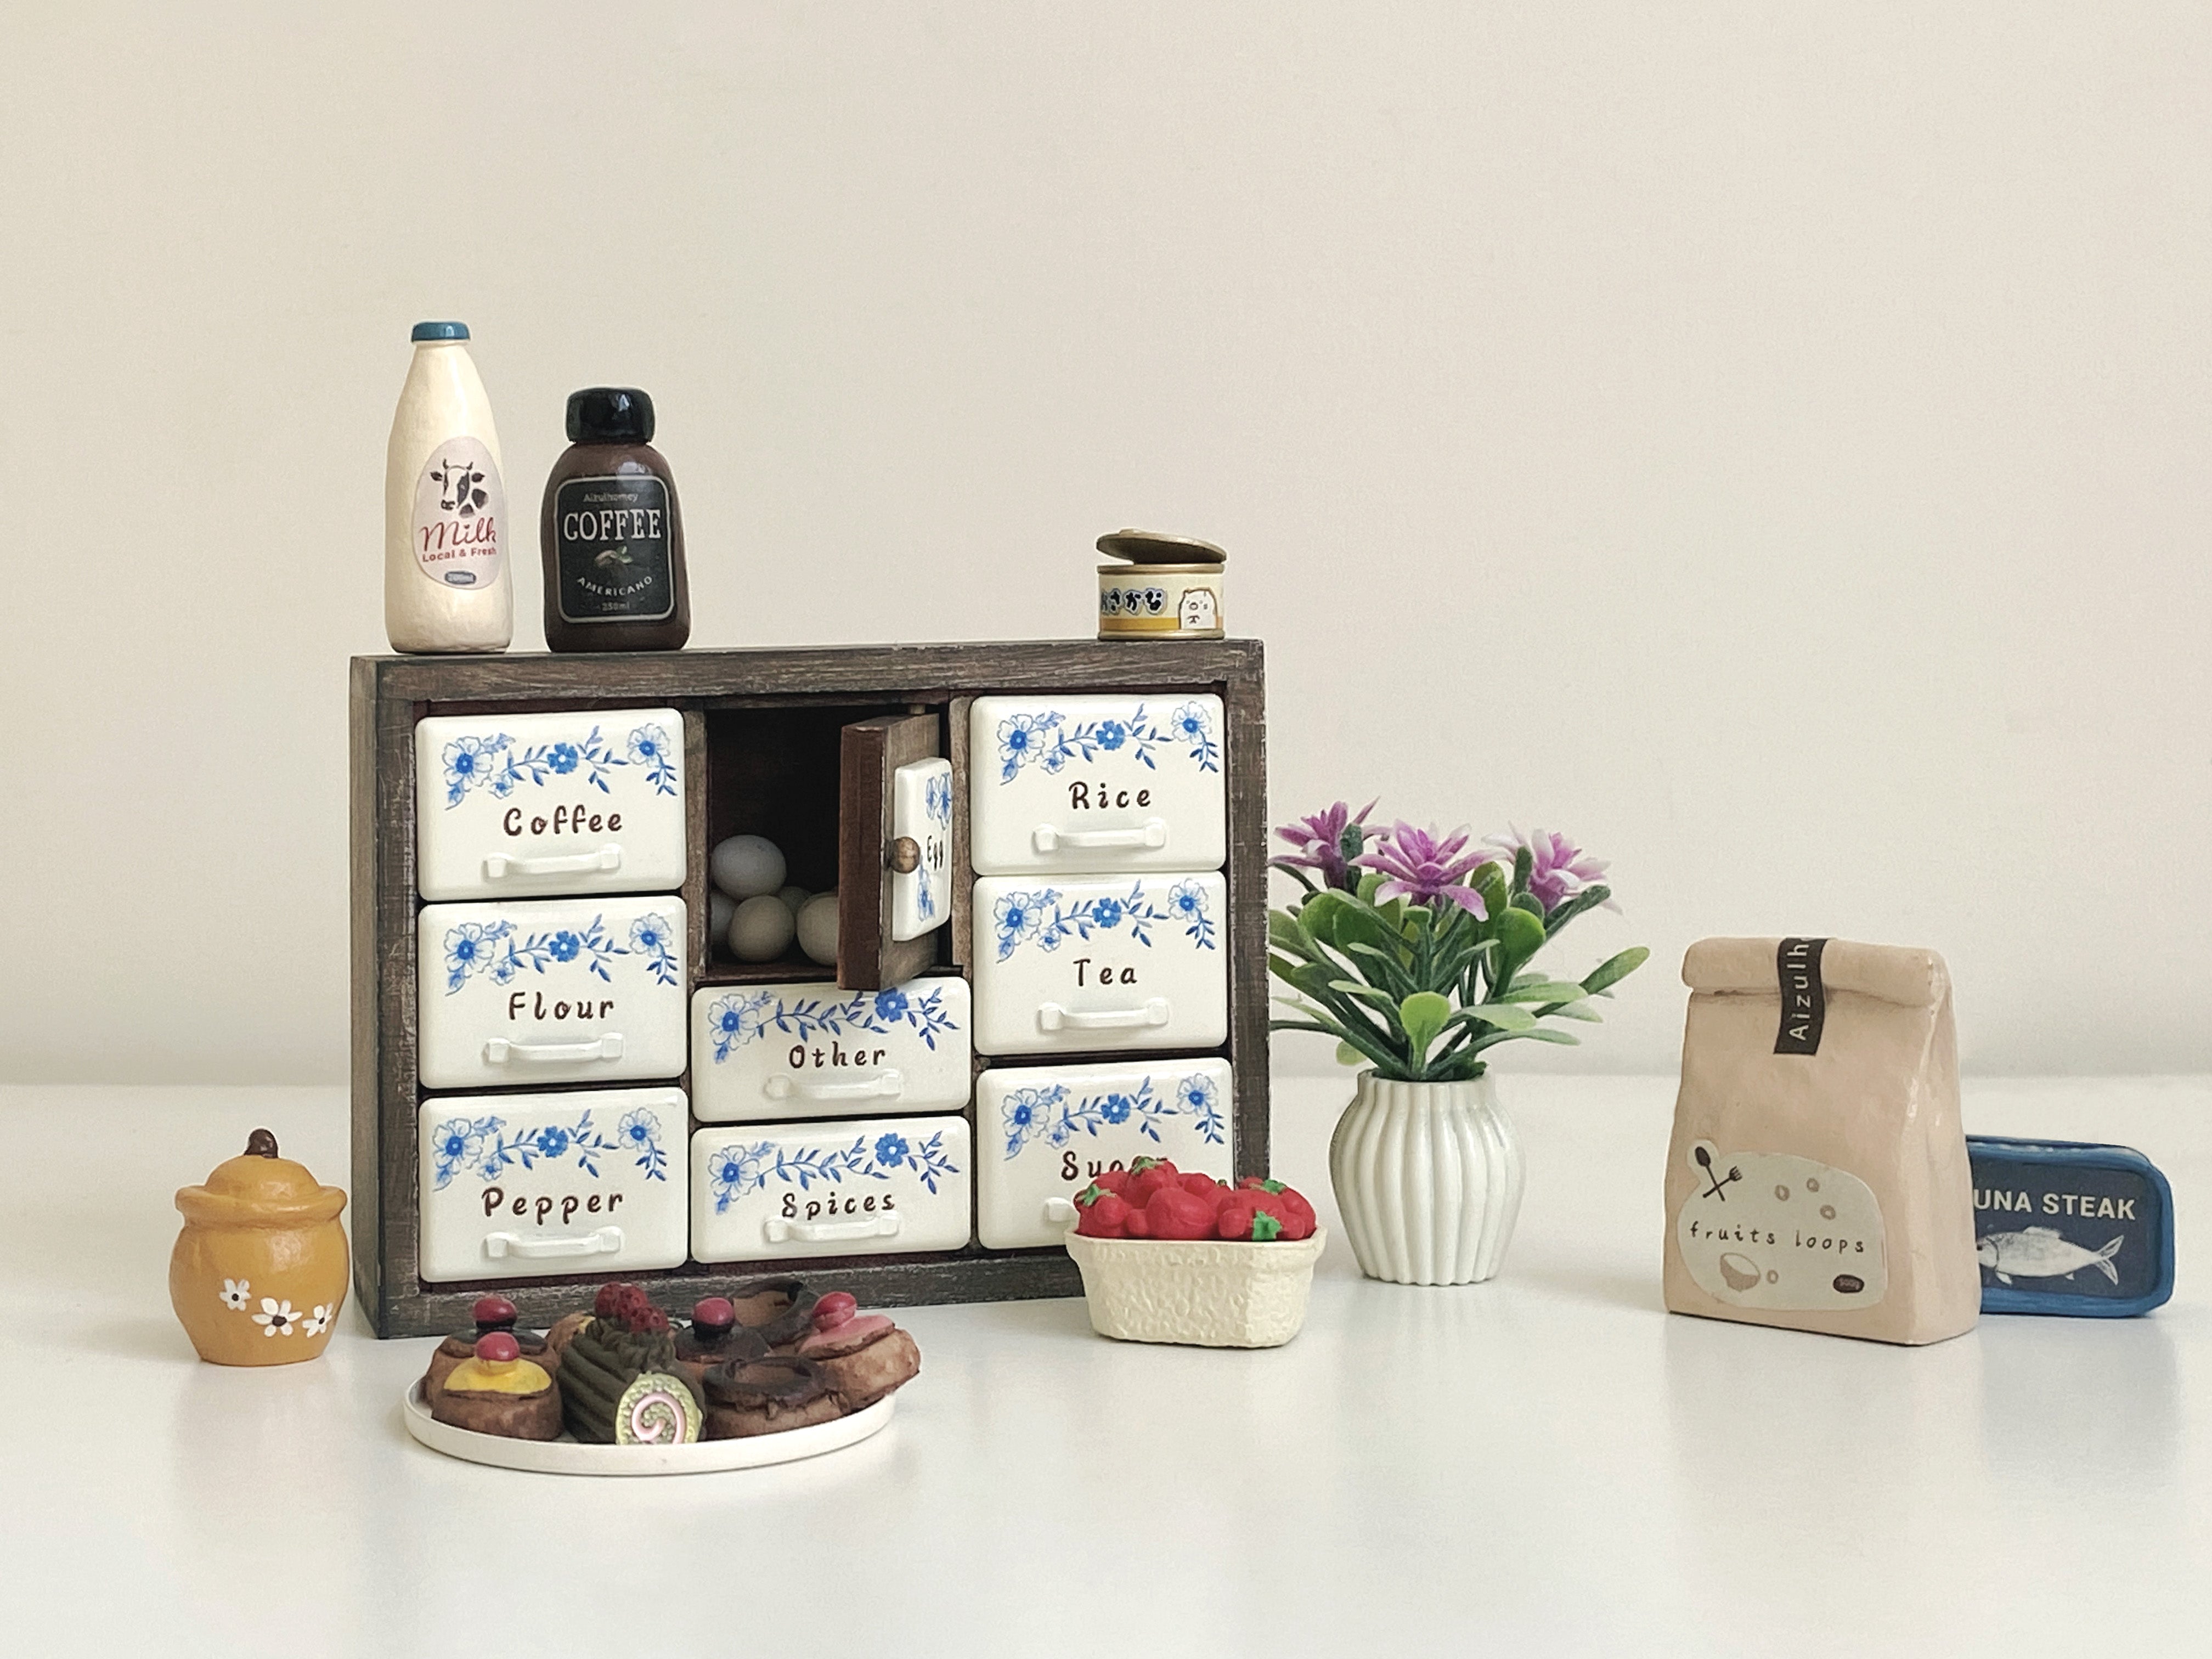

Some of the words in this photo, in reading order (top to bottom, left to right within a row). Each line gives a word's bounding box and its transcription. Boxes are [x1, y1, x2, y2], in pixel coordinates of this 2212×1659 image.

[419, 517, 496, 551] Milk
[563, 509, 662, 541] COFFEE
[422, 549, 455, 562] Local
[459, 549, 466, 557] &
[471, 548, 497, 556] Fresh
[577, 576, 653, 596] AMERICANO
[1068, 781, 1151, 810] Rice
[503, 804, 623, 837] Coffee
[927, 835, 943, 871] Egg
[1073, 958, 1138, 987] Tea
[1786, 938, 1811, 1041] Aizulh
[509, 991, 614, 1020] Flour
[789, 1041, 886, 1069] Other
[481, 1186, 623, 1226] Pepper
[782, 1191, 895, 1221] Spices
[2042, 1193, 2136, 1220] STEAK
[1690, 1221, 1775, 1245] fruits
[1796, 1229, 1864, 1254] loops
